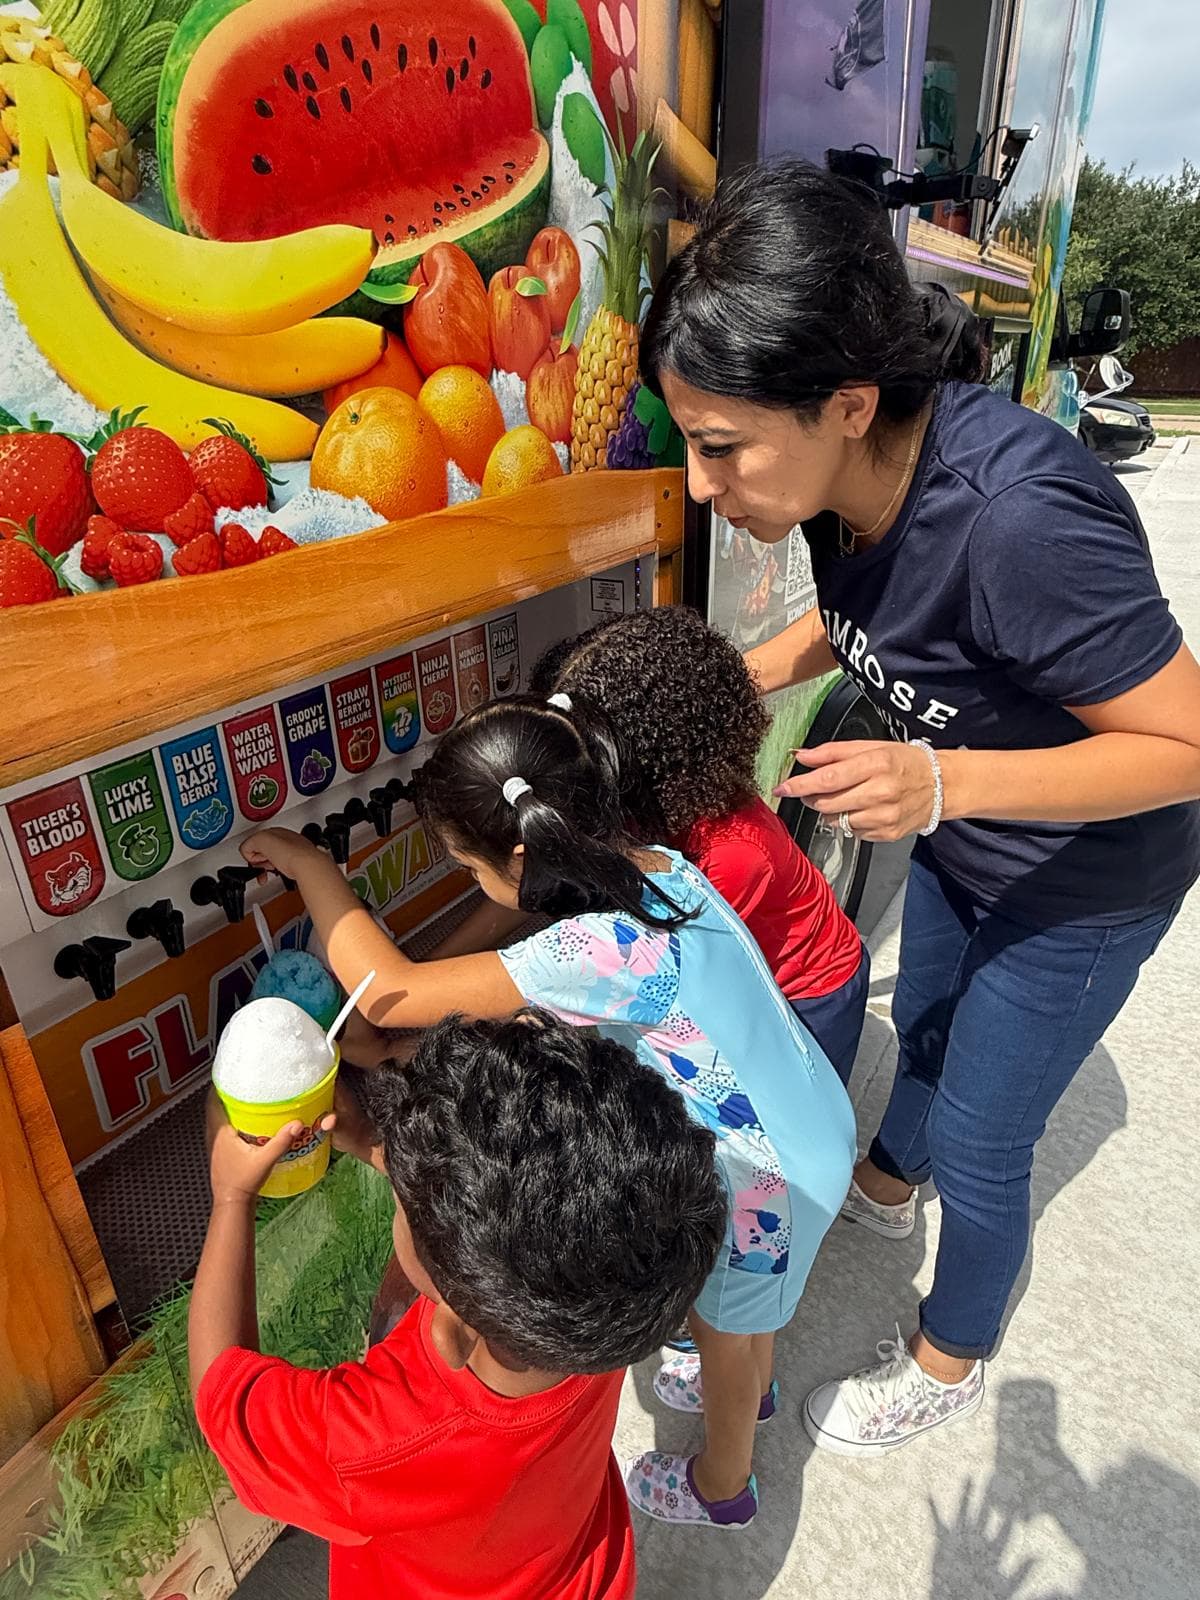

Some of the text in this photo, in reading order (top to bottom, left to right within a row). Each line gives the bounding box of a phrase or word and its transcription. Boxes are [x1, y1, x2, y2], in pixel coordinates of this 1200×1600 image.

[493, 626, 515, 647] PIÑA
[421, 654, 449, 675] NINJA
[459, 652, 485, 670] MANGO
[823, 609, 959, 730] IMROSE
[382, 670, 411, 689] MYSTERY
[422, 667, 450, 687] CHERRY
[336, 684, 368, 708] STRAW
[338, 698, 371, 720] BERRY'D
[286, 703, 324, 728] GROOVY
[288, 715, 327, 743] GRAPE
[340, 709, 372, 730] TREASURE
[232, 722, 271, 747] WATER
[234, 734, 274, 762] MELON
[172, 743, 214, 775] BLUE
[237, 749, 277, 776] WAVE
[176, 761, 217, 792] RASP
[104, 776, 148, 805] LUCKY
[180, 779, 218, 807] BERRY
[21, 802, 81, 838] TIGER'S
[108, 791, 154, 824] LIME
[26, 820, 86, 857] BLOOD
